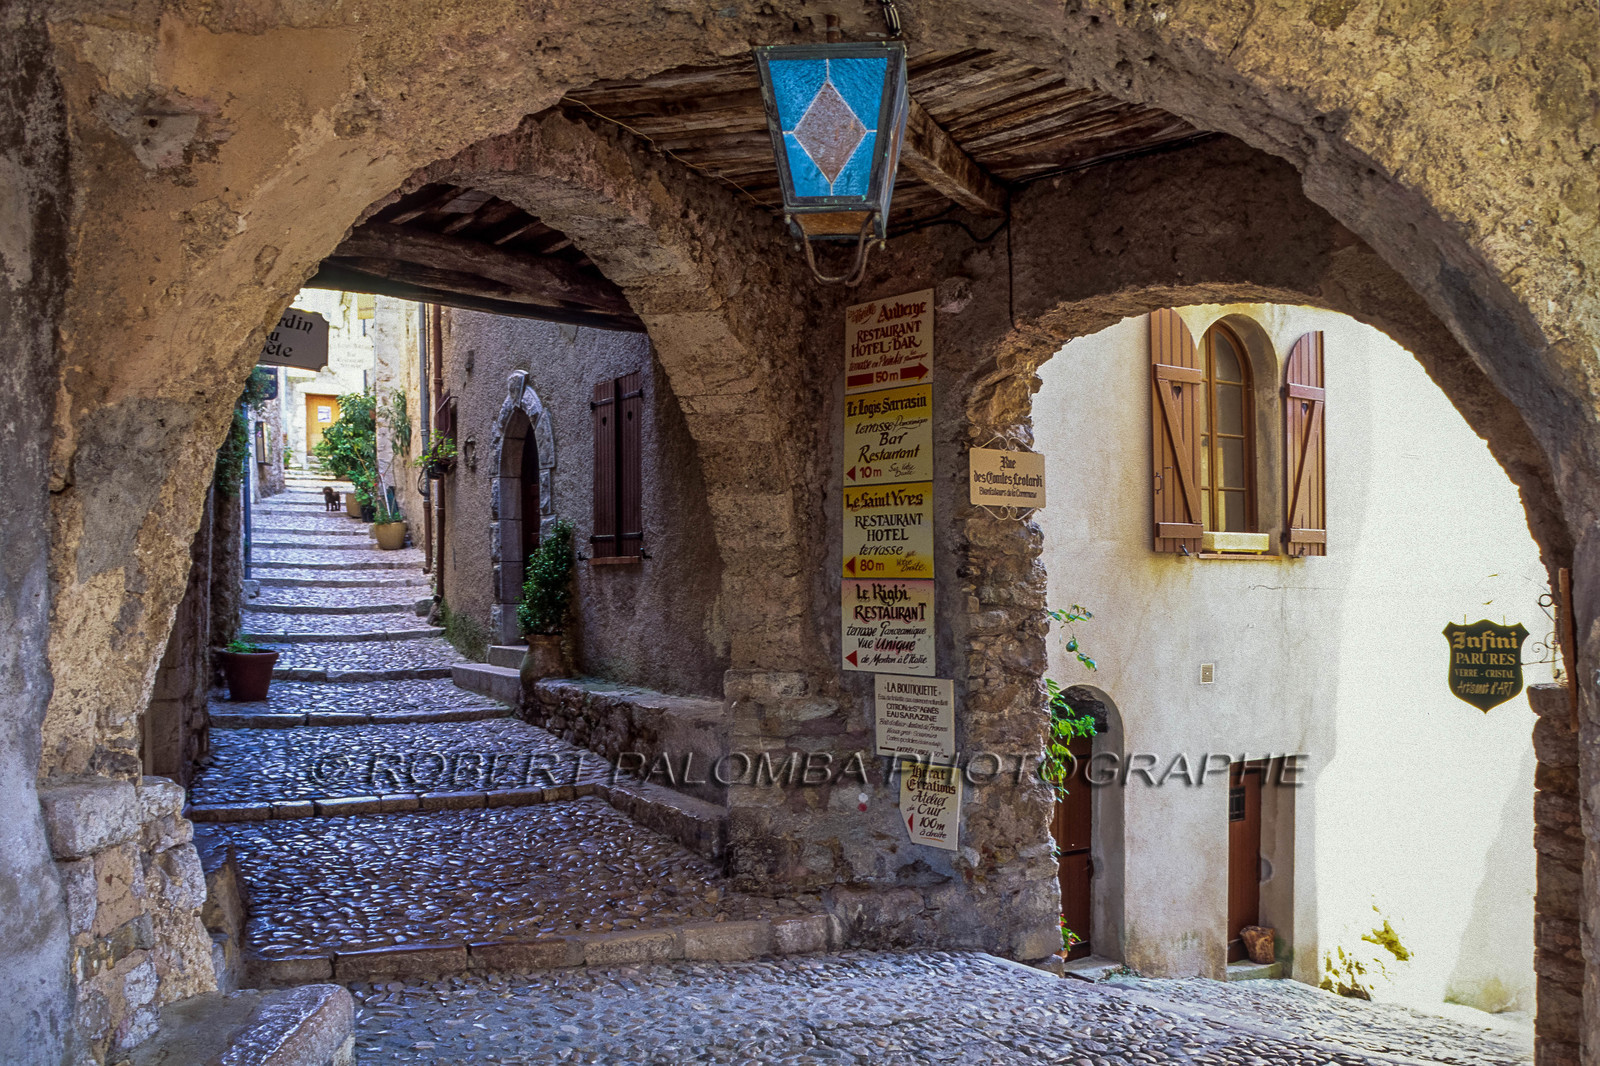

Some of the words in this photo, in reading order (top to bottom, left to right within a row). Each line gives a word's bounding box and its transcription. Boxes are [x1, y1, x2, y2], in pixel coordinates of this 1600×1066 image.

[877, 302, 927, 323] Auberge
[277, 315, 313, 334] rdin
[266, 333, 279, 341] u
[857, 320, 921, 343] RESTAURANT
[876, 371, 888, 382] 50
[890, 372, 898, 380] m
[847, 401, 858, 417] Le
[859, 399, 881, 418] Logis
[881, 393, 927, 414] Sarrasin
[855, 422, 893, 434] terrasse
[879, 432, 908, 446] Bar
[858, 444, 920, 463] Restaurant
[1000, 456, 1016, 471] Rue
[860, 466, 872, 478] 10
[874, 469, 882, 477] m
[974, 470, 986, 483] des
[986, 471, 1012, 485] Comtes
[846, 494, 861, 511] Le
[860, 492, 890, 508] Saint
[891, 489, 923, 507] Yves
[855, 513, 923, 529] RESTAURANT
[867, 529, 909, 541] HOTEL
[859, 544, 903, 555] terrasse
[860, 560, 874, 571] 80
[875, 563, 884, 571] m
[856, 584, 870, 600] Le
[872, 584, 909, 606] Righi
[855, 602, 927, 623] RESTAURANT
[847, 623, 877, 636] terrasse
[880, 621, 927, 638] Panoramique
[858, 638, 873, 649] Vue
[1452, 630, 1518, 652] Infini
[861, 655, 869, 663] de
[869, 653, 896, 665] Menton
[1456, 653, 1516, 665] PARURES
[1455, 669, 1479, 677] VERRE
[1485, 670, 1515, 678] CRISTAL
[887, 682, 896, 692] LA
[887, 703, 907, 711] CITRON
[900, 713, 937, 722] SARAZINE
[912, 791, 949, 807] Atelier
[918, 804, 946, 817] Cuir
[926, 830, 947, 838] droite
